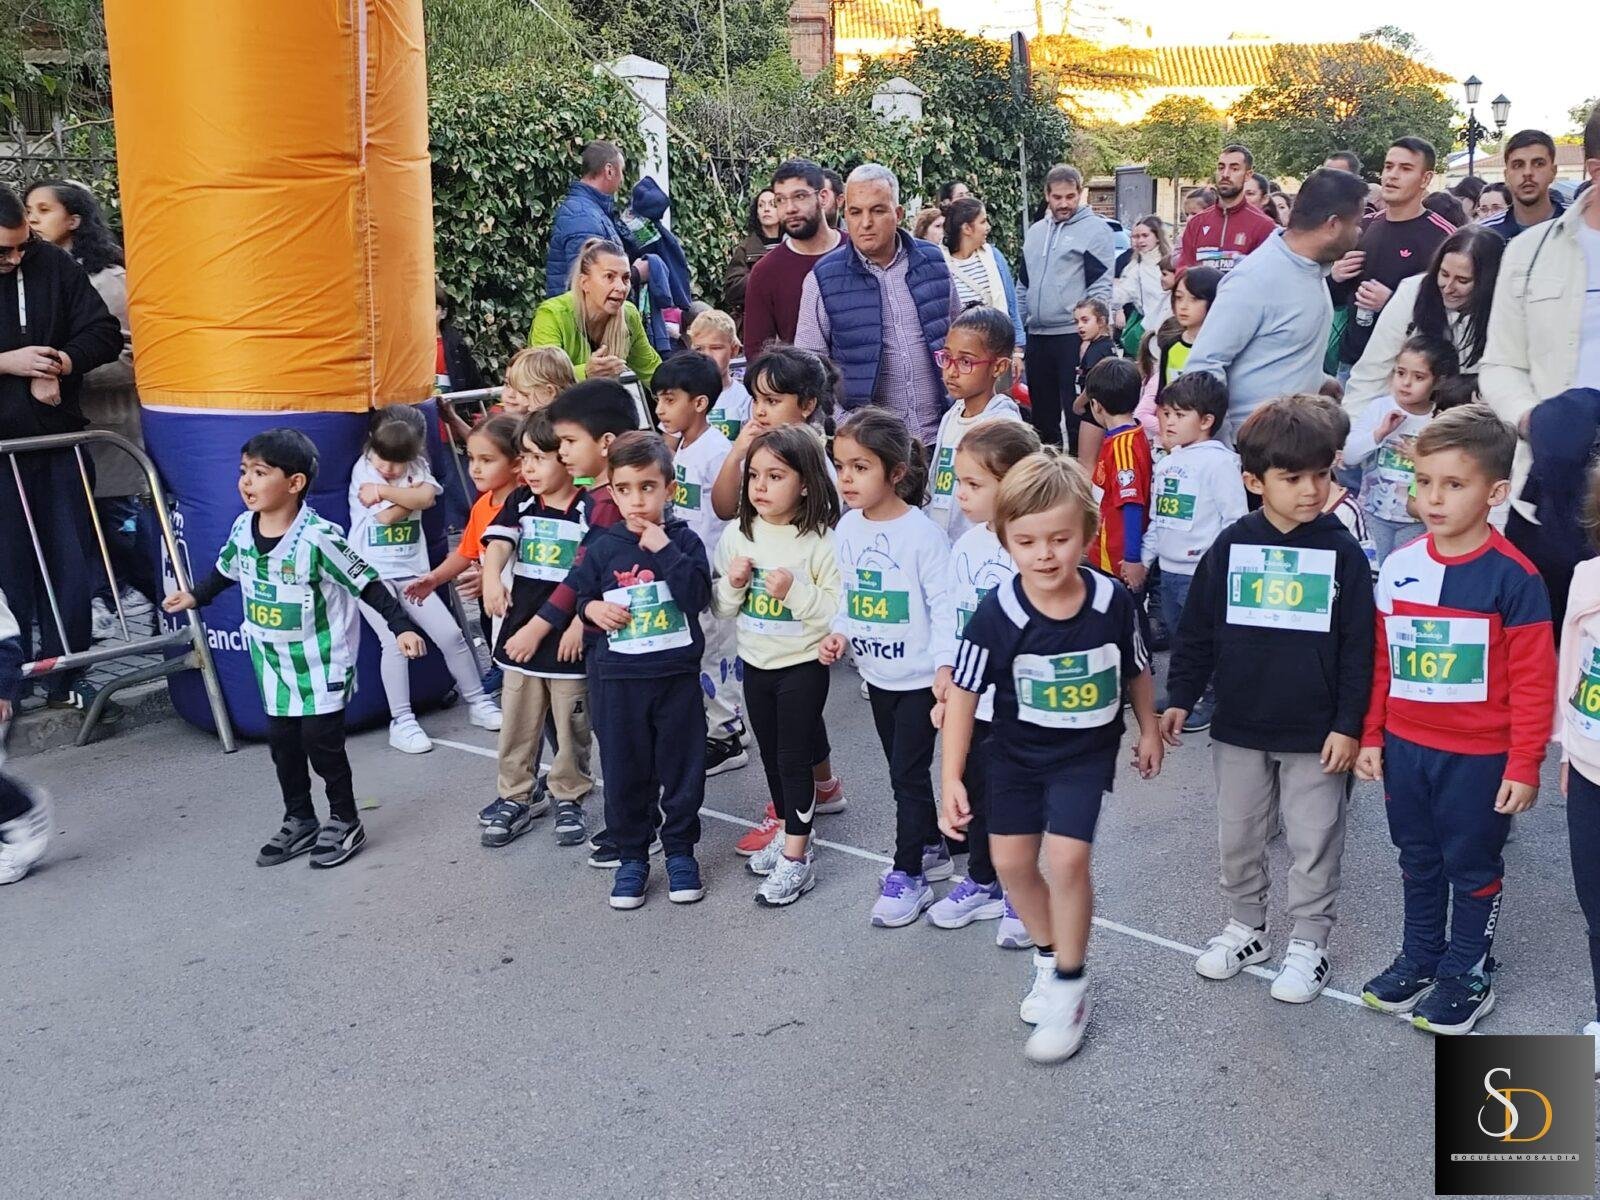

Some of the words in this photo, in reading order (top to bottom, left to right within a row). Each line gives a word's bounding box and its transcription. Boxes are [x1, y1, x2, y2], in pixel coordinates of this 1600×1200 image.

[1157, 496, 1179, 514] 133
[384, 526, 412, 543] 137
[527, 542, 562, 564] 132
[748, 592, 784, 617] 160
[1251, 578, 1303, 607] 150
[250, 602, 283, 627] 165
[852, 594, 889, 620] 154
[629, 608, 669, 637] 174
[851, 636, 905, 660] STITCH
[1406, 650, 1458, 679] 167
[1043, 682, 1099, 709] 139
[1579, 679, 1600, 712] 16
